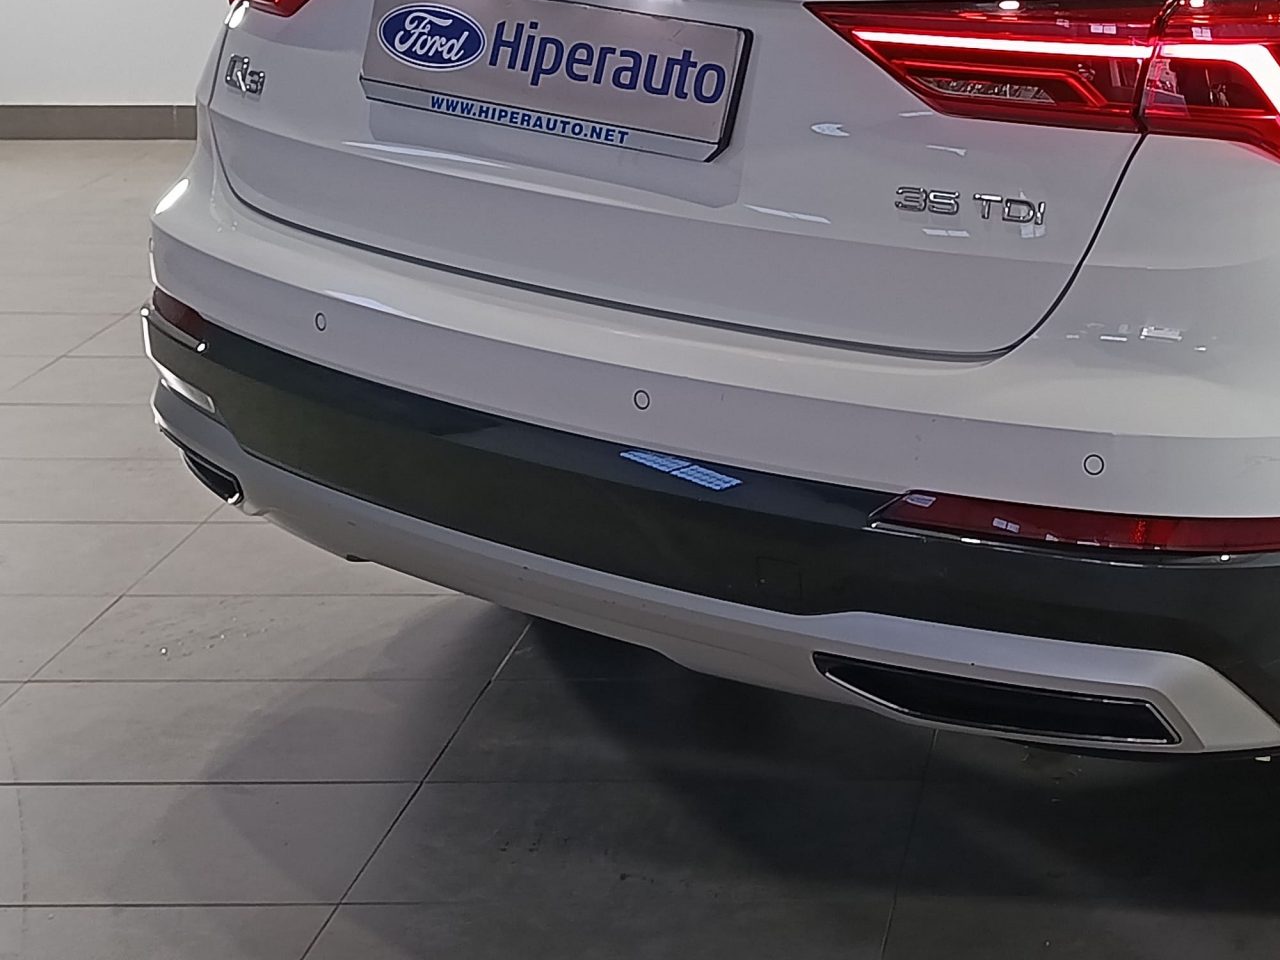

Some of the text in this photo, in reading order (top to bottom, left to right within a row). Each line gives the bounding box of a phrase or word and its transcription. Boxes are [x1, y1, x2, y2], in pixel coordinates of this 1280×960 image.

[225, 54, 266, 96] Q3
[394, 11, 726, 105] Ford Hiperauto
[431, 95, 629, 145] WWW.HIPERAUTO.NET
[895, 186, 1047, 226] 35 TDI
